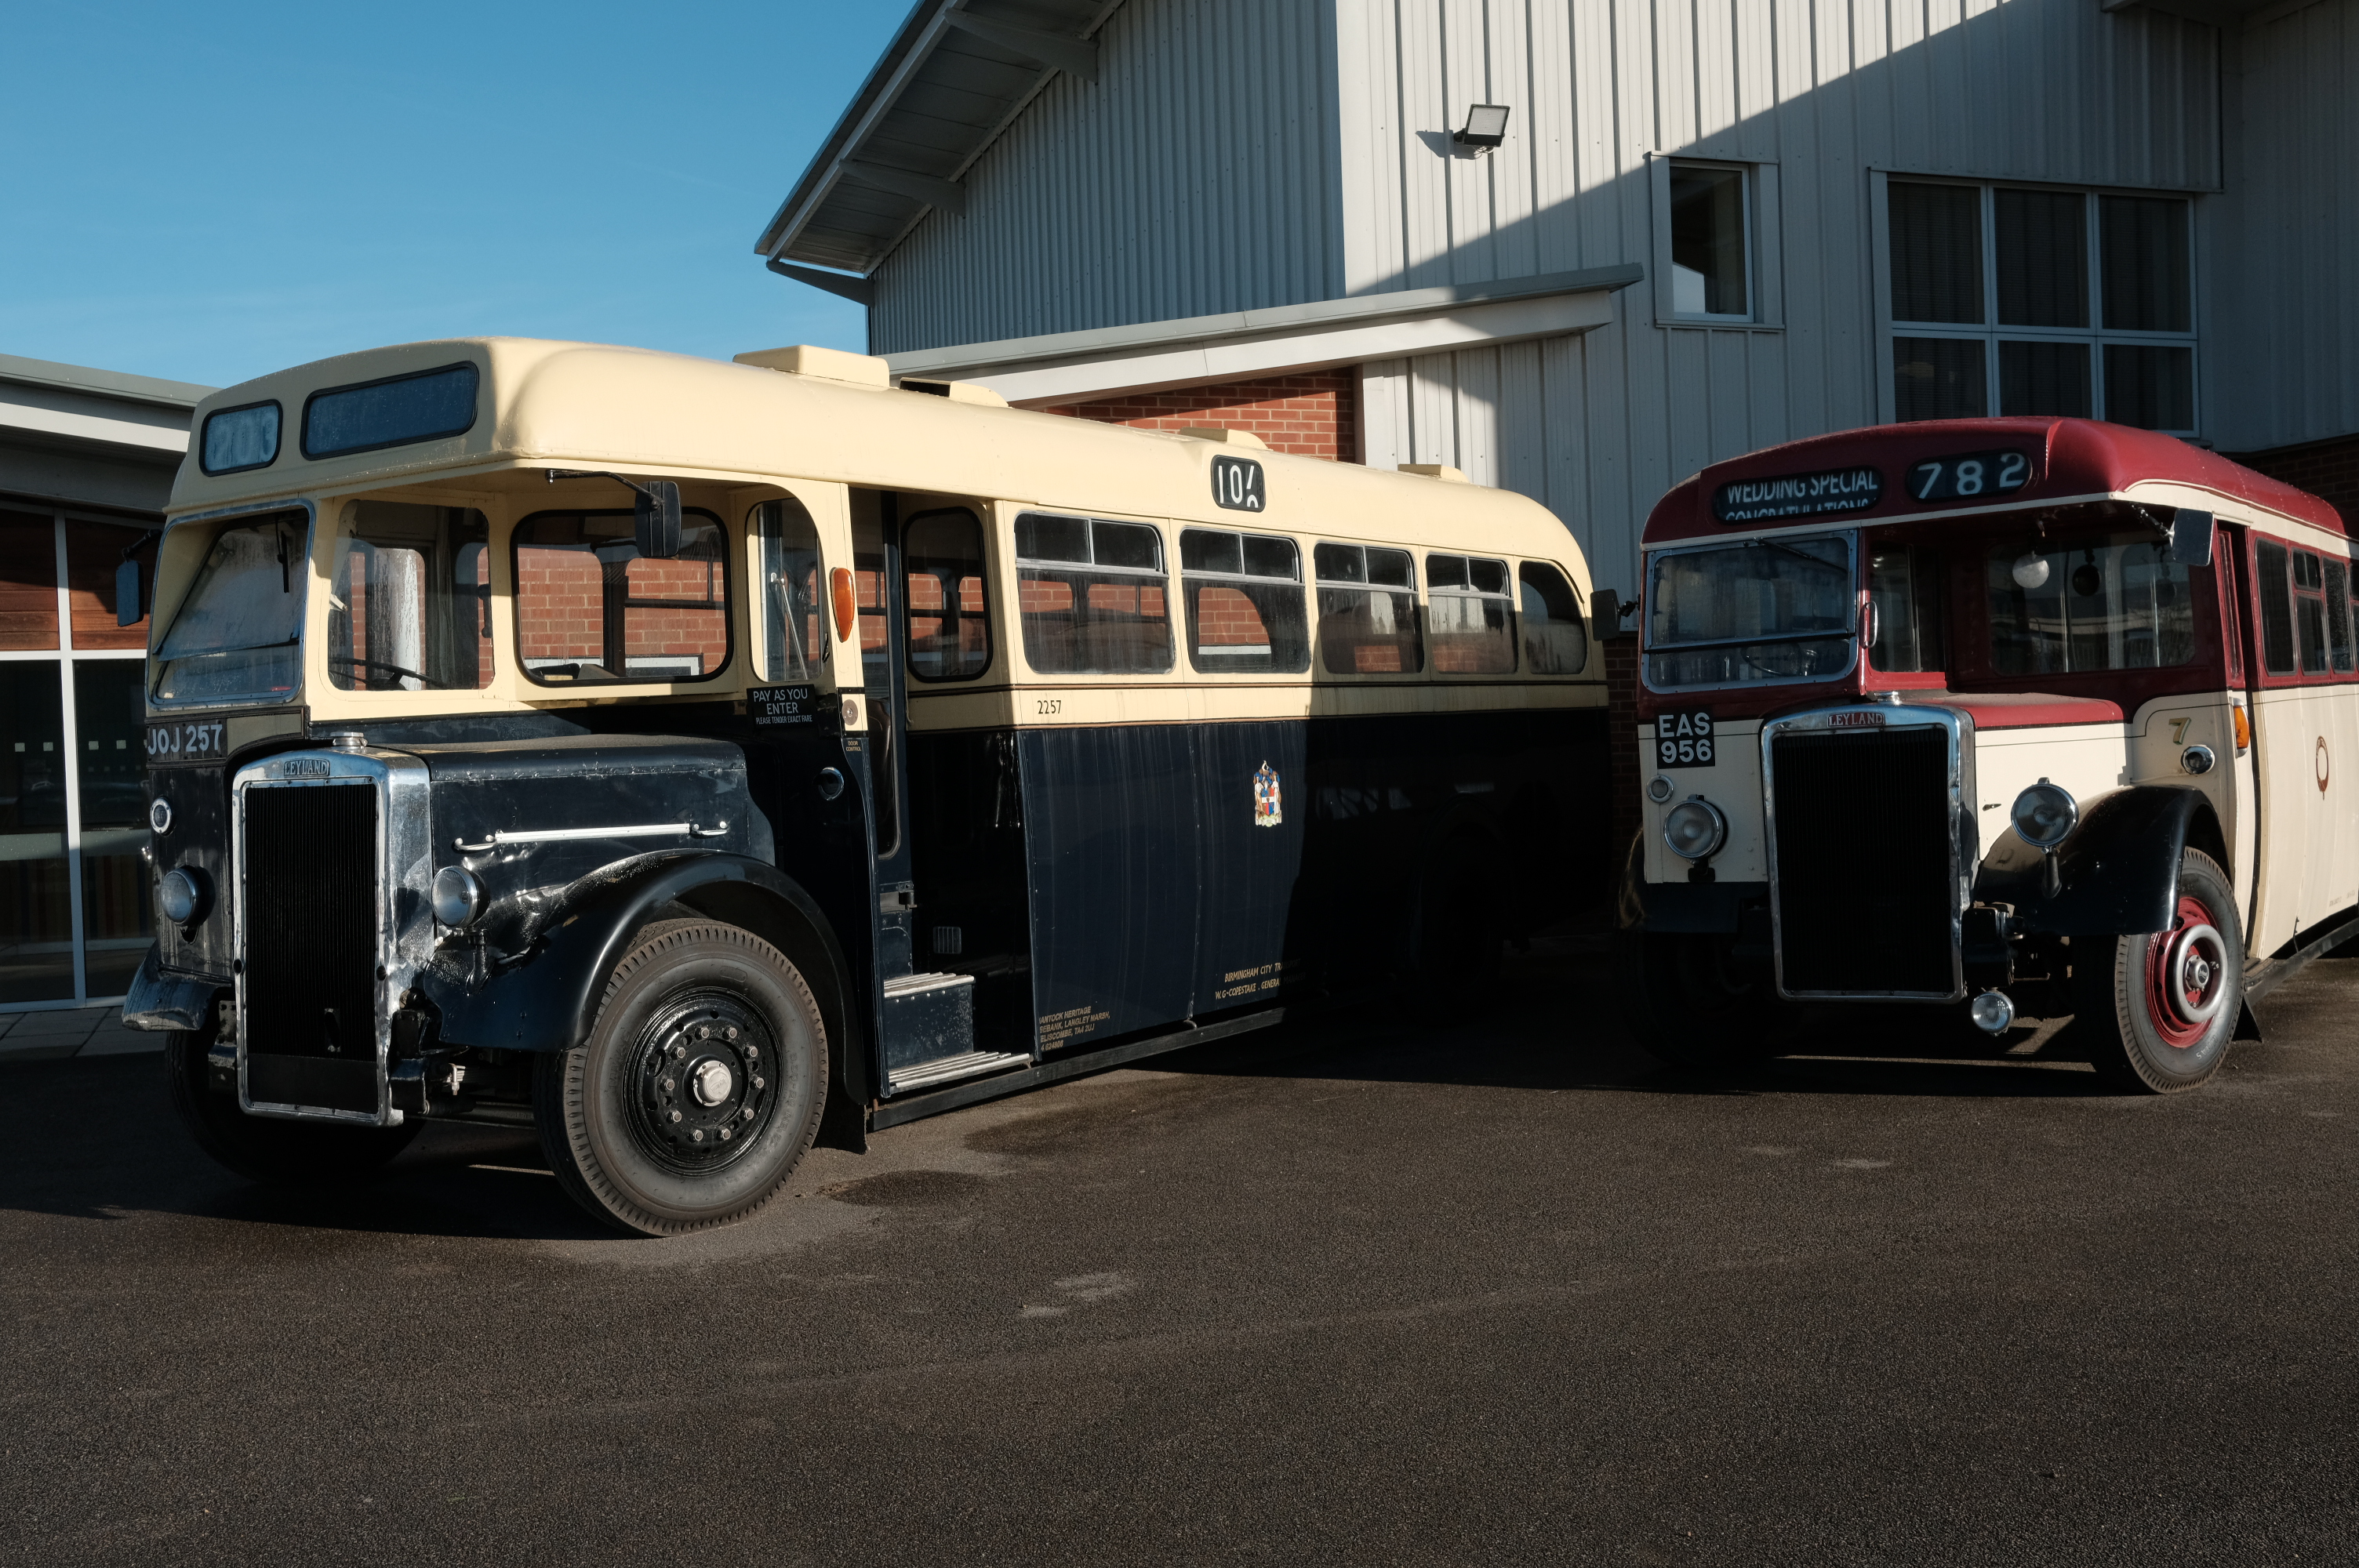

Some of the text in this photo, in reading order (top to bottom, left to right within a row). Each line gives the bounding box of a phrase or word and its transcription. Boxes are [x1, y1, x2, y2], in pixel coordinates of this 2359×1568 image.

[1917, 452, 2026, 499] 782
[1728, 470, 1878, 504] WEDDING SPECIAL
[753, 688, 809, 702] PAY AS YOU
[766, 702, 799, 715] ENTER
[1037, 700, 1061, 714] 2257
[755, 714, 813, 725] PLEASE TENDER EXACT FARE
[1658, 712, 1710, 738] EAS
[1828, 713, 1883, 727] LEYLAND
[147, 724, 223, 755] JOJ 257
[2168, 717, 2192, 746] 7
[1660, 739, 1712, 764] 956
[285, 760, 328, 776] LEYLAND
[1225, 967, 1259, 983] BIRMINGHAM
[1260, 964, 1272, 975] CITY
[1064, 1006, 1092, 1019] HERITAGE
[1064, 1016, 1090, 1028] LANGLEY
[1090, 1011, 1110, 1022] MARSH,
[1085, 1023, 1095, 1032] 2UJ
